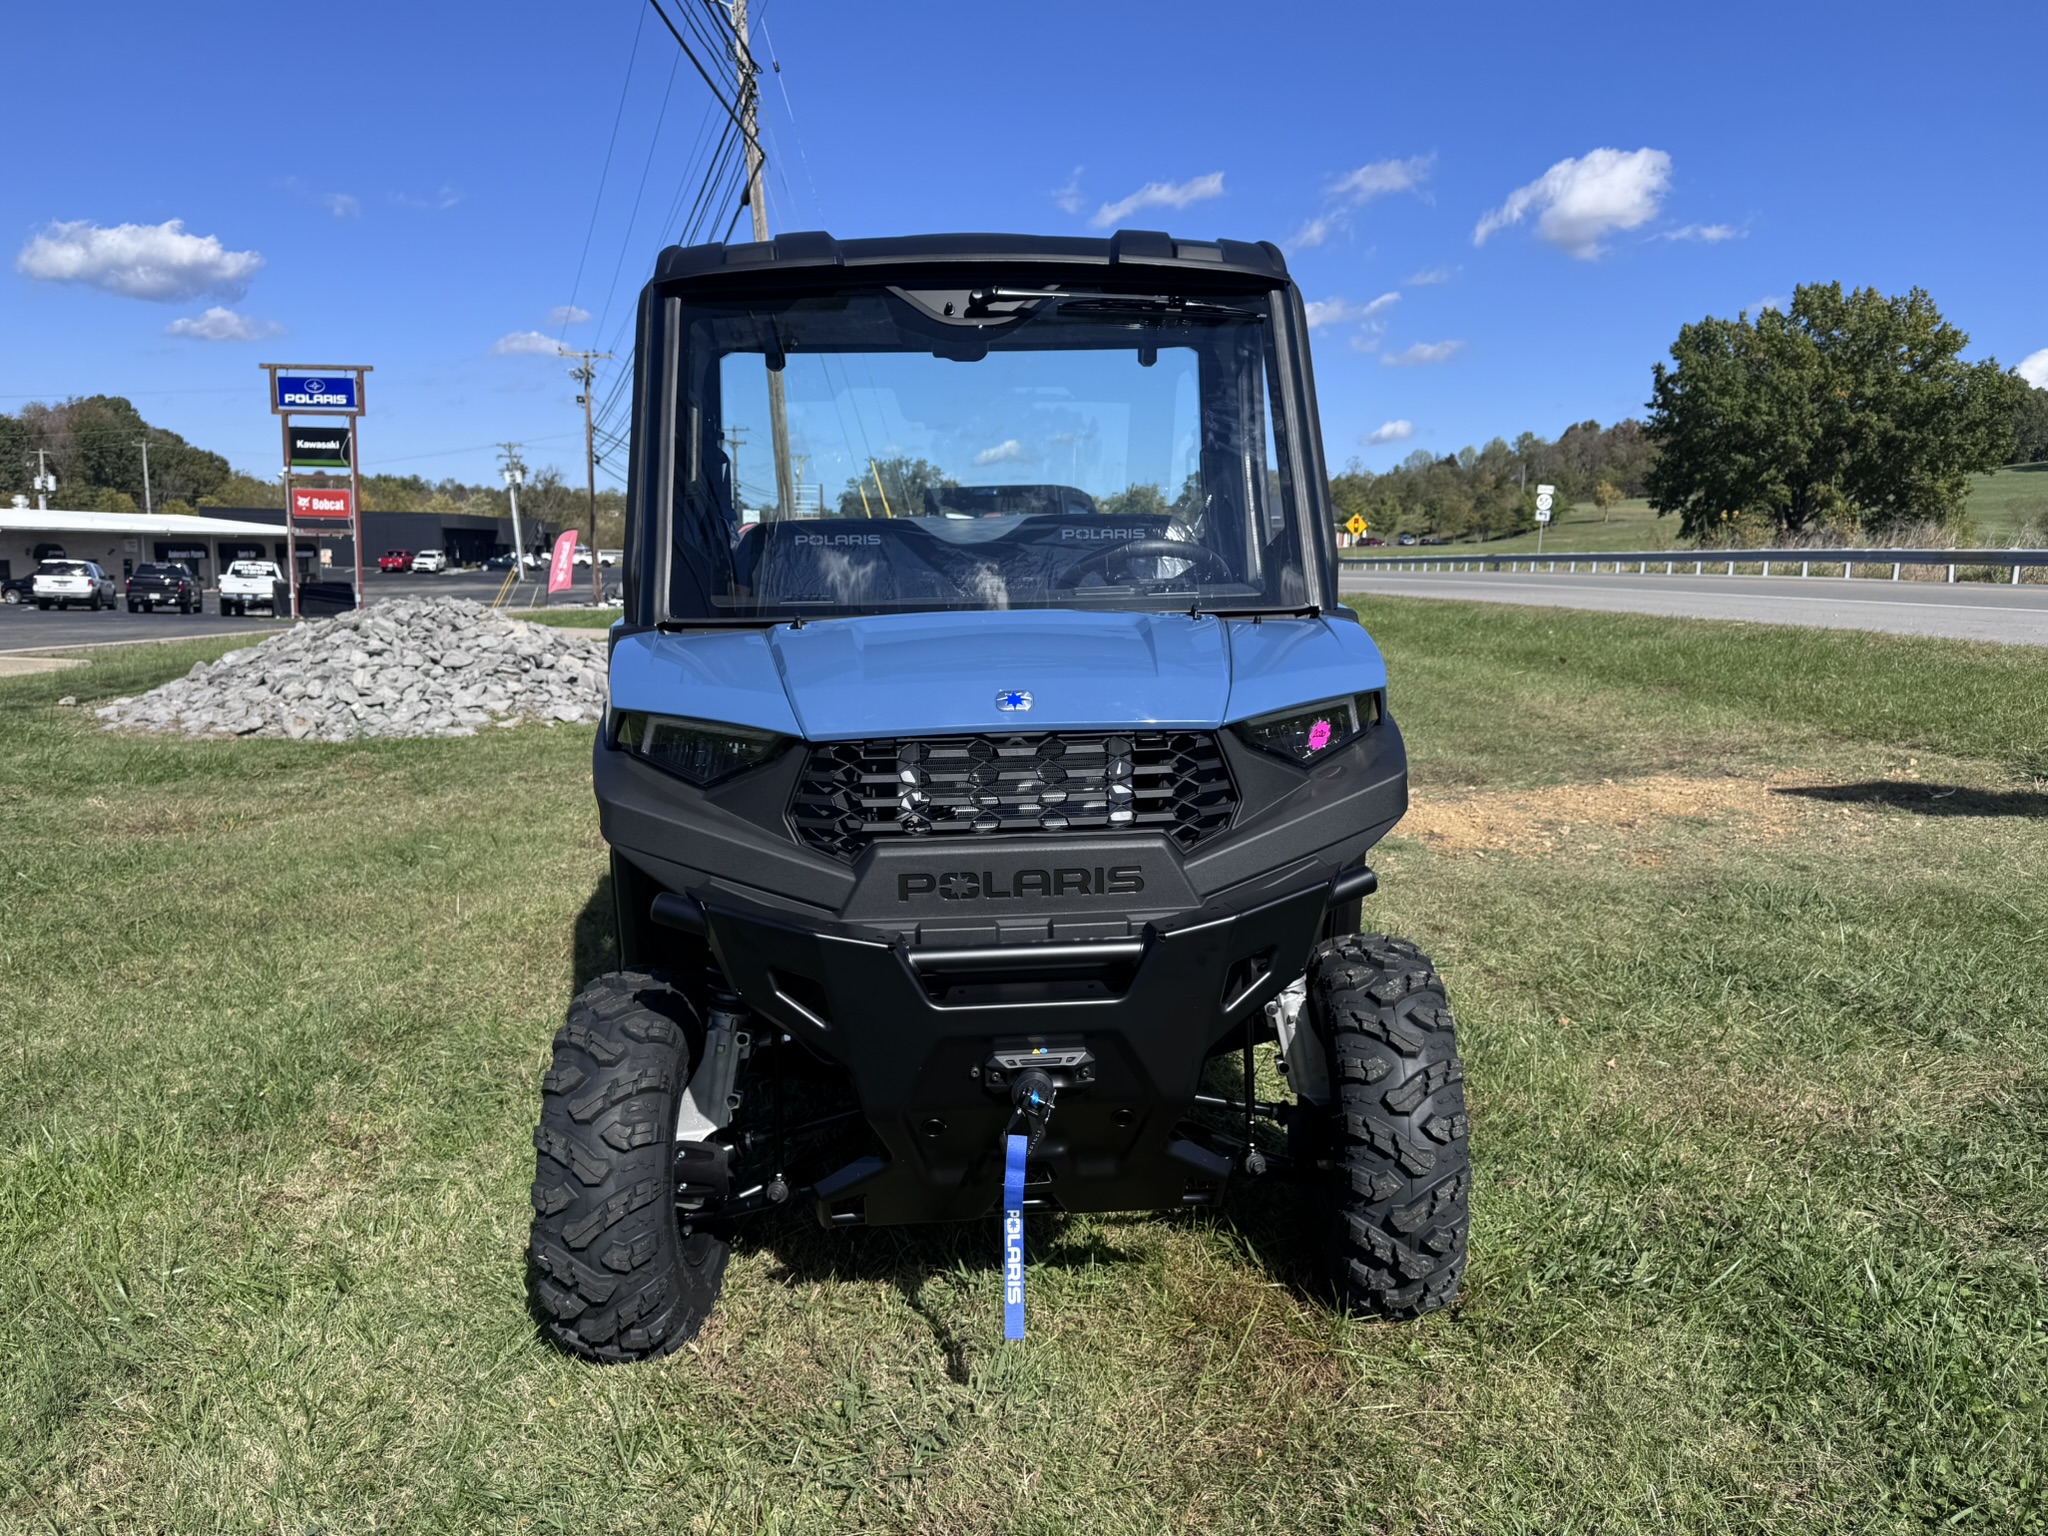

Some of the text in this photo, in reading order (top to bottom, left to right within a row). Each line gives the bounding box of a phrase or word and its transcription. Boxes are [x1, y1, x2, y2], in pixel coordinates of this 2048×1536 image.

[284, 393, 347, 405] POLARIS
[296, 439, 340, 450] Kawasaki
[312, 498, 344, 511] Bobcat
[794, 533, 881, 546] POLARIS
[1061, 528, 1146, 540] POLARIS
[898, 865, 1145, 903] POLARIS
[1006, 1210, 1022, 1305] POLARIS
